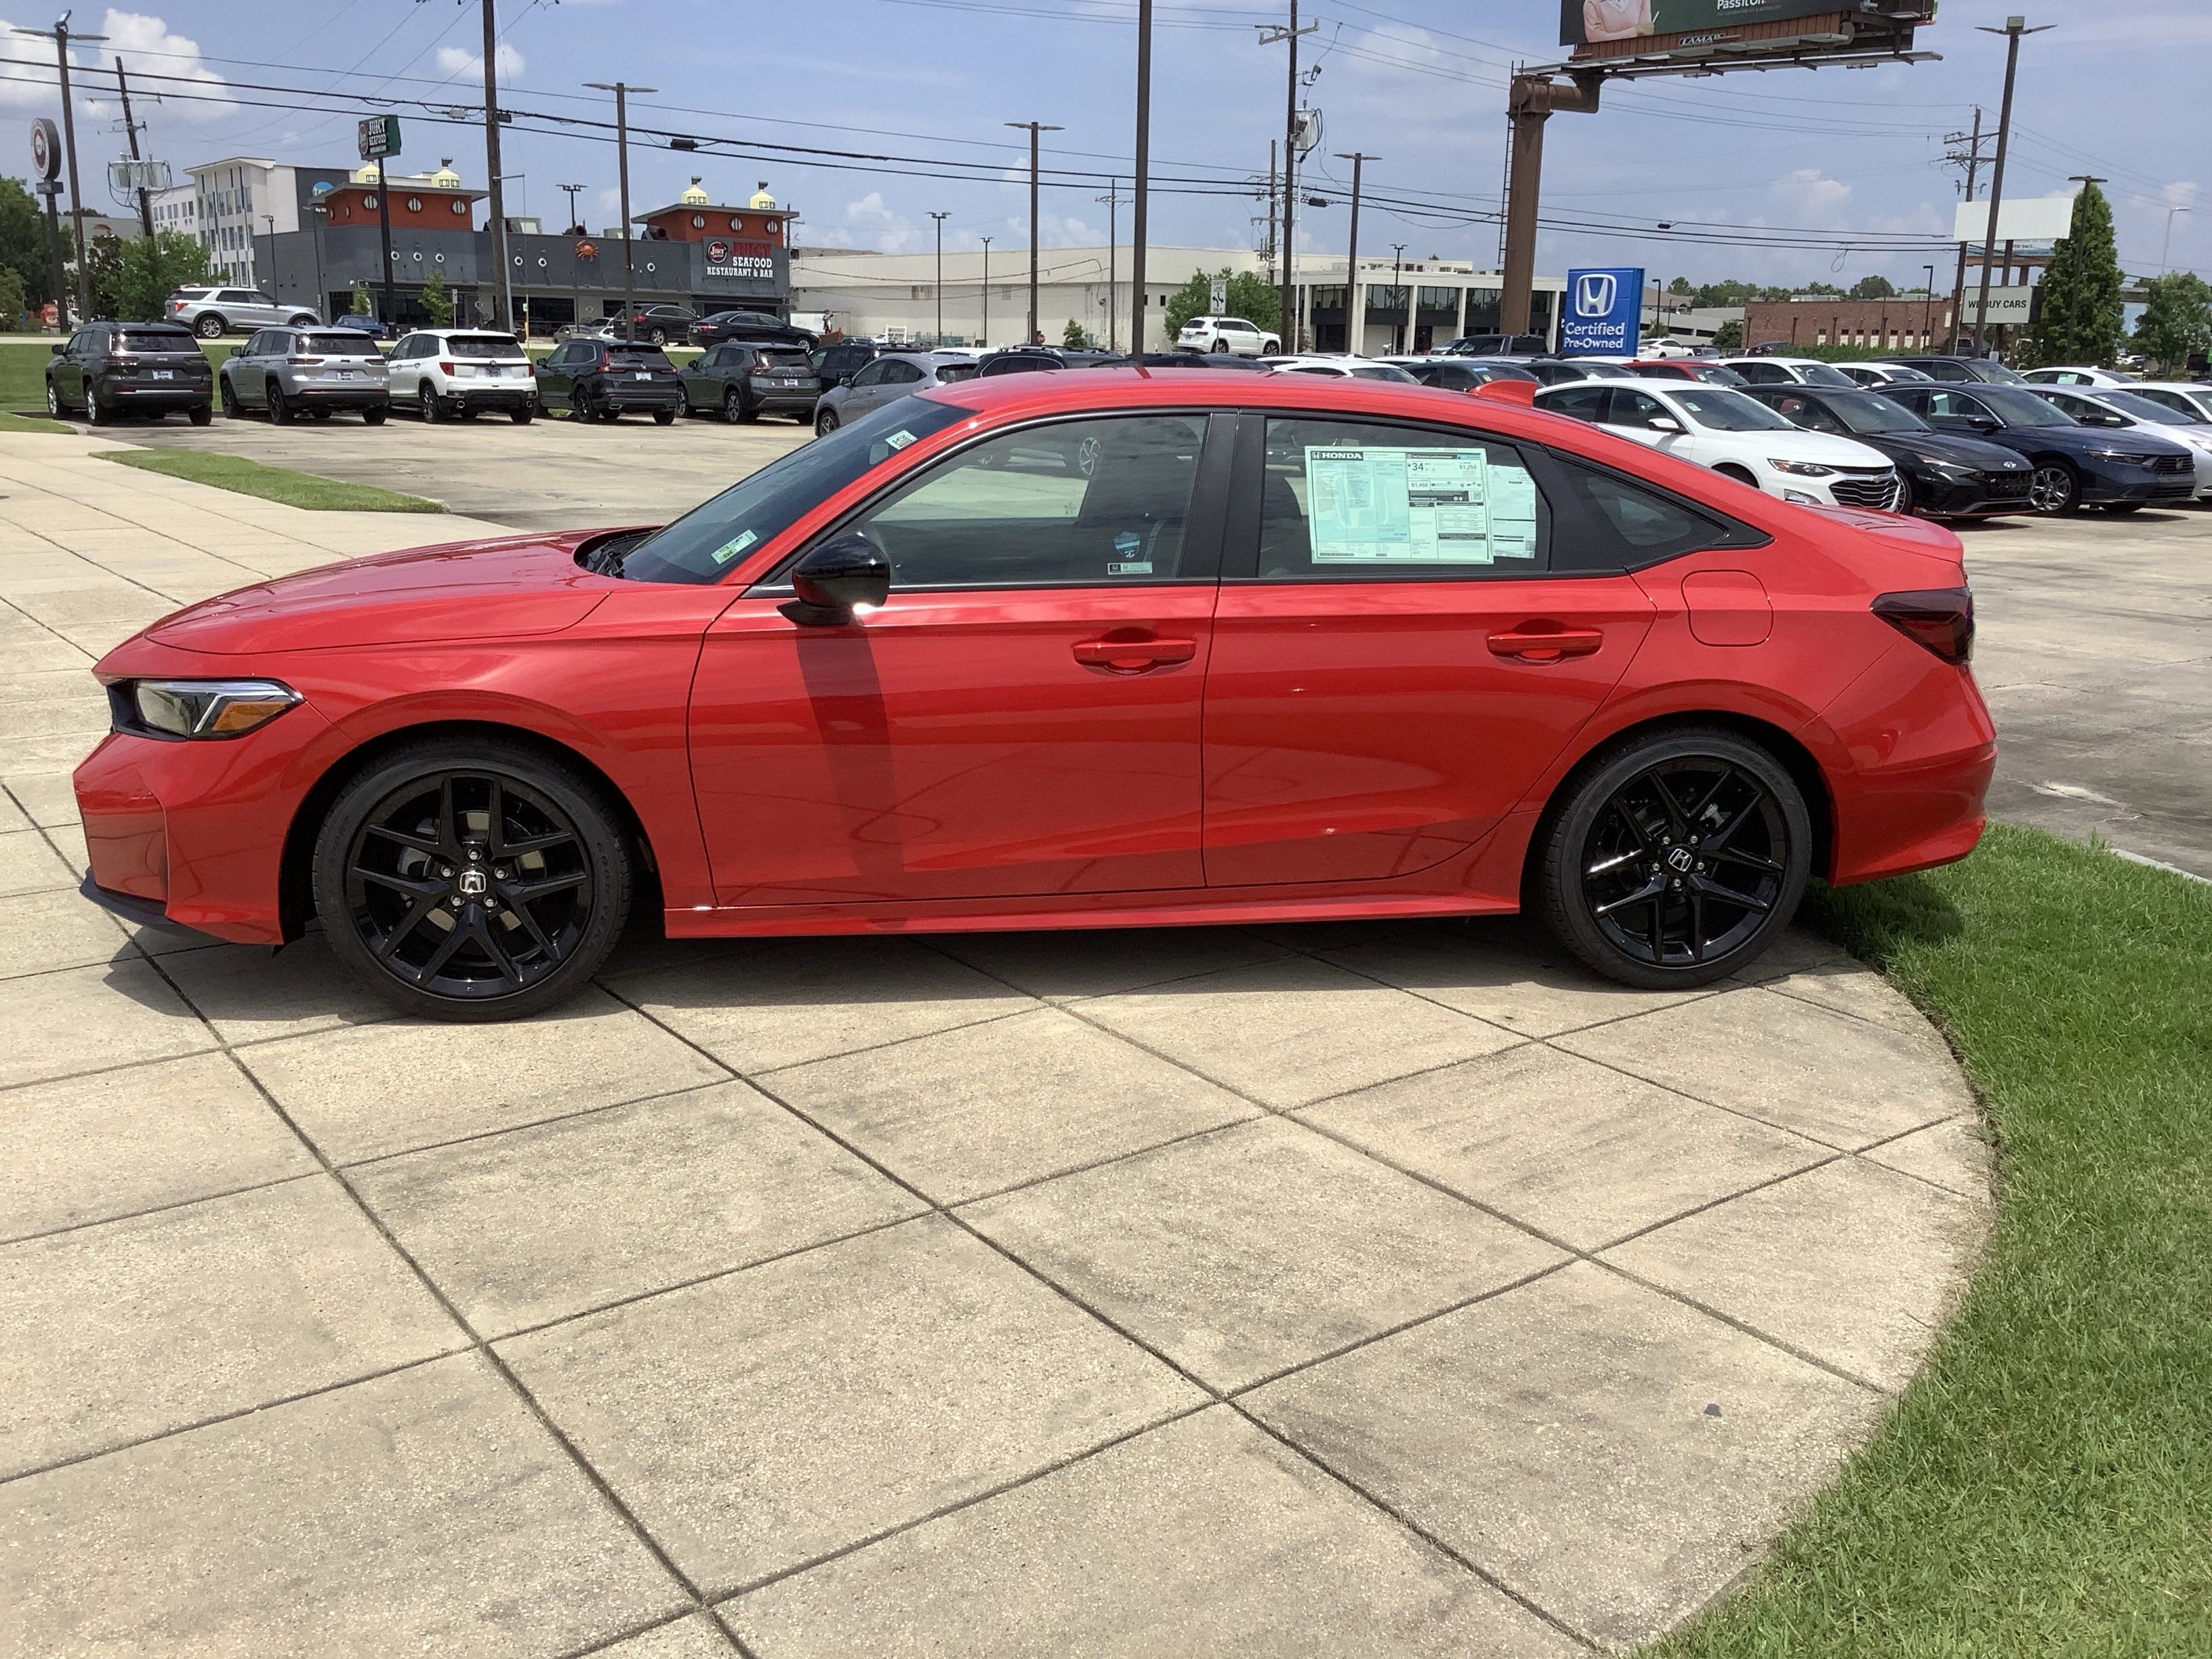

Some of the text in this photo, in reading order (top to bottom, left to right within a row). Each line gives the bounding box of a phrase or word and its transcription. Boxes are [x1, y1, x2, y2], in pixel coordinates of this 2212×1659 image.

[369, 118, 386, 136] JUICY
[731, 242, 771, 258] JUICY
[733, 256, 773, 268] SEAFOOD
[707, 266, 773, 278] RESTAURANT & BAR
[2003, 300, 2027, 308] CARS
[1565, 322, 1625, 335] Certified
[1563, 337, 1624, 348] Pre-Owned
[1412, 463, 1424, 471] 34
